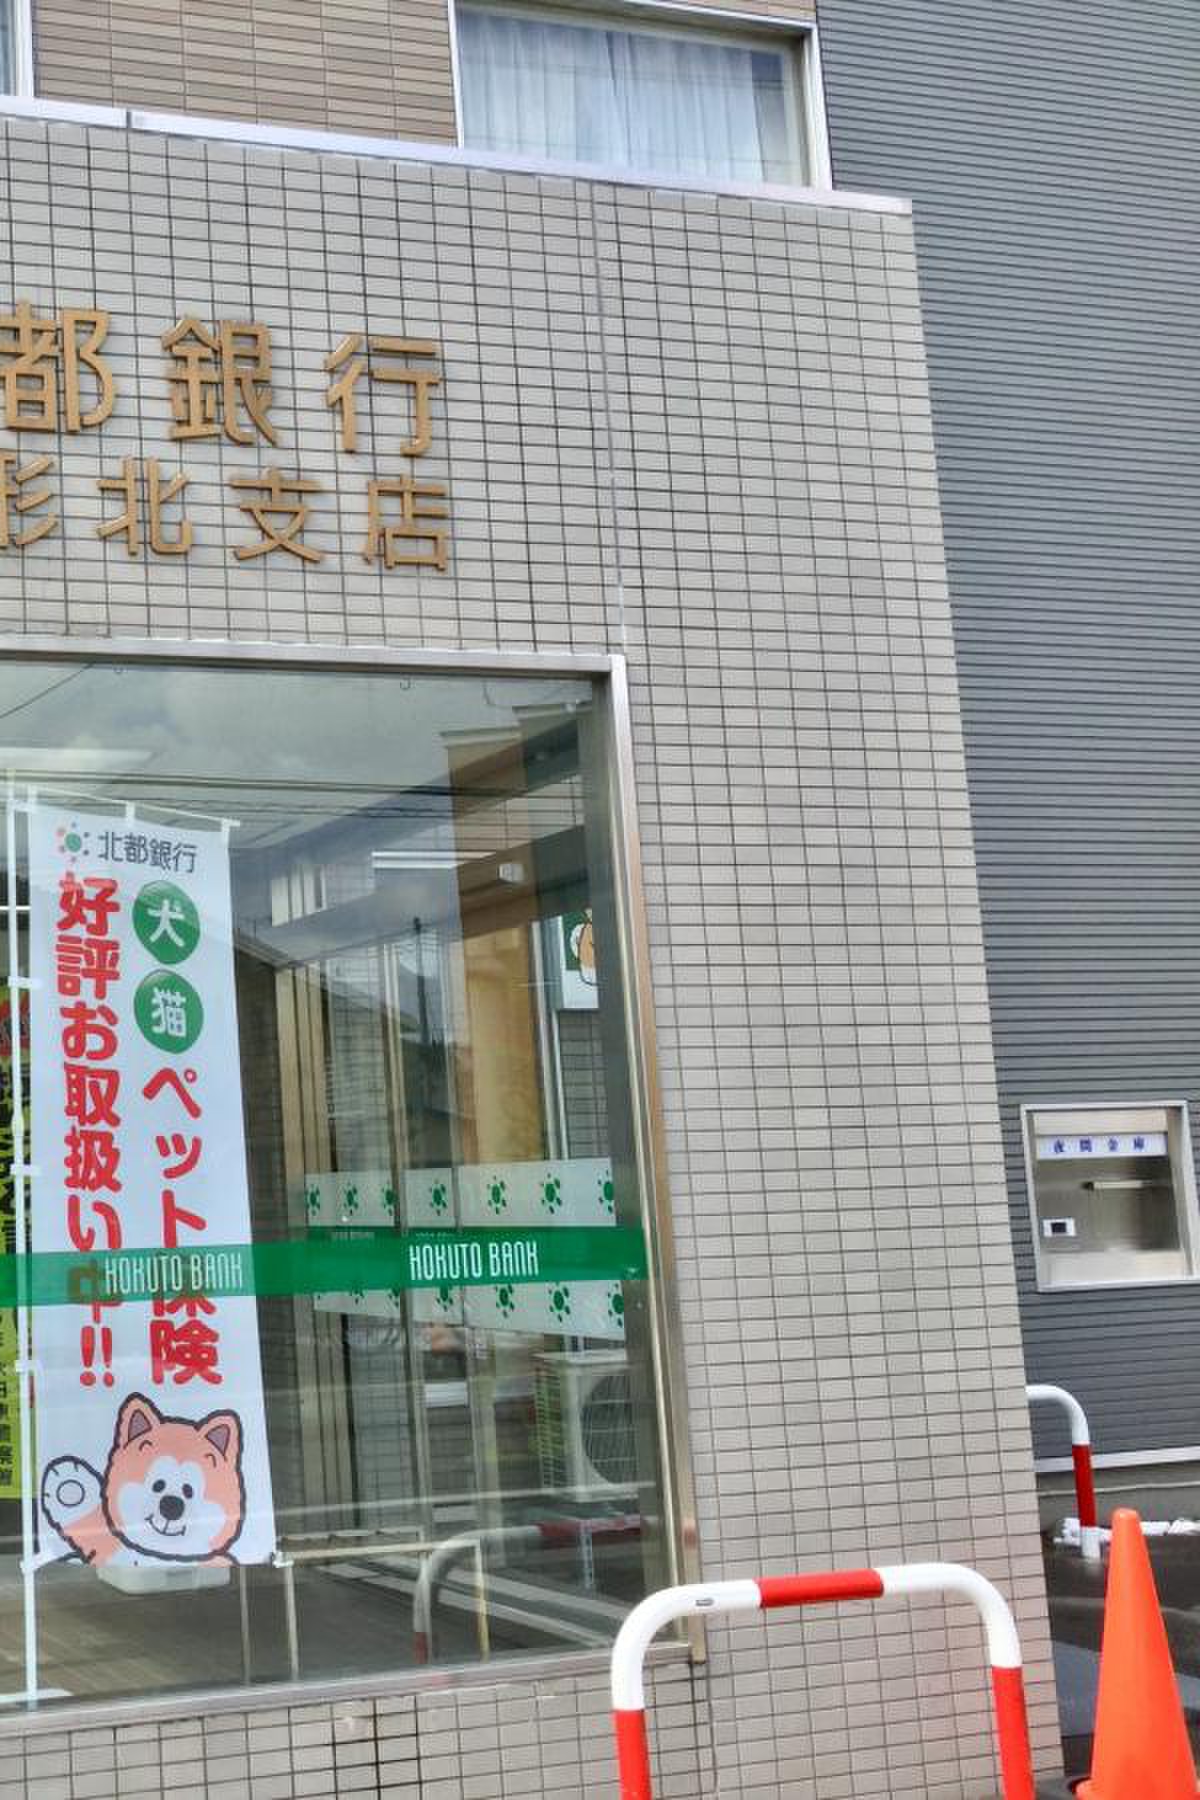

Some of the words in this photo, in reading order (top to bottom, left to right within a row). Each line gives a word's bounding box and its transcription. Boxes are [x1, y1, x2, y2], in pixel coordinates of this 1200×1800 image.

[97, 831, 198, 873] 北都銀行
[104, 1255, 184, 1295] HOKUTO
[190, 1253, 243, 1291] BANK
[409, 1242, 482, 1280] HOKUTO
[488, 1240, 540, 1277] BANK
